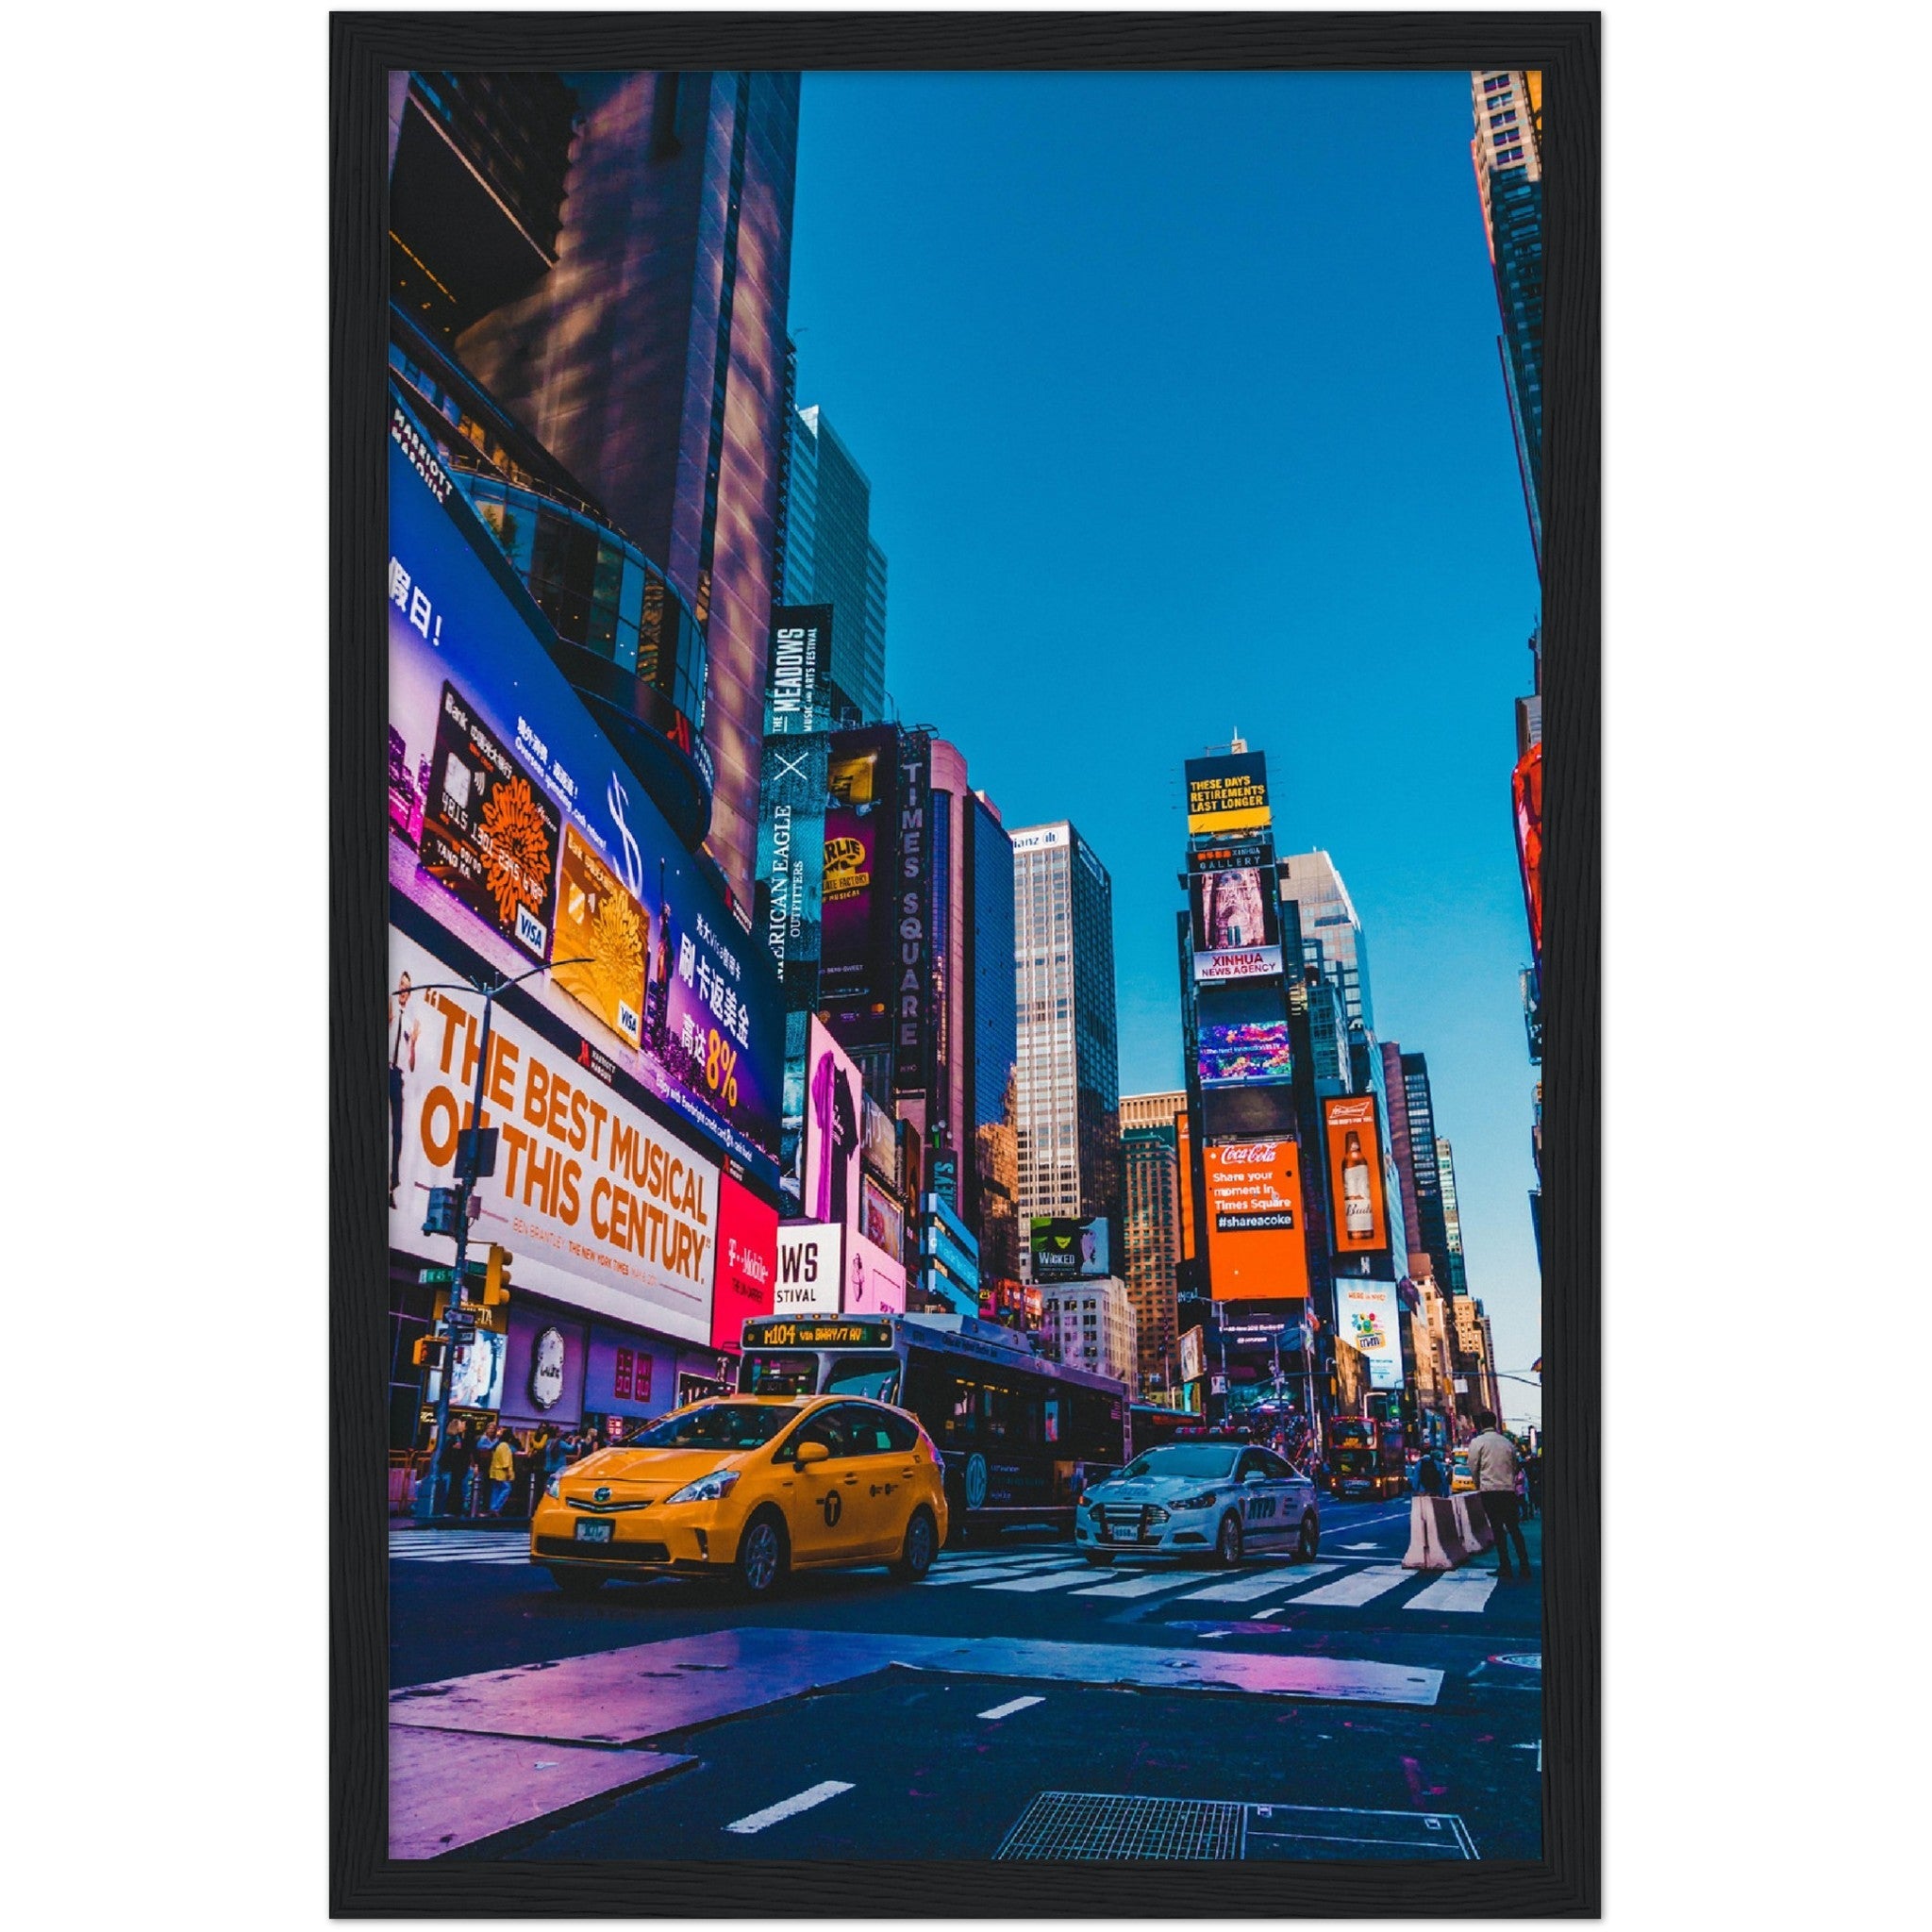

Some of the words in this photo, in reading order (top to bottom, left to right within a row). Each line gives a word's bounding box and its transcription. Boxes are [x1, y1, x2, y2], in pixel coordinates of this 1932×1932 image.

[806, 628, 818, 666] FESTIVAL
[773, 628, 806, 712] MEADOWS
[806, 668, 816, 690] ARTS
[773, 716, 783, 734] THE
[804, 705, 814, 732] MUSIC
[1191, 778, 1222, 791] THESE
[1224, 775, 1251, 787] DAYS
[1191, 785, 1265, 803] RETIREMENTS
[1191, 801, 1218, 812] LAST
[1221, 796, 1263, 809] LONGER
[900, 762, 924, 879] TIMES
[773, 805, 791, 874] EAGLE
[1199, 857, 1261, 869] GALLERY
[839, 874, 867, 888] FACTORY
[790, 860, 804, 939] OUTFITTERS
[828, 890, 860, 902] MUSICAL
[520, 912, 543, 950] VISA
[768, 878, 788, 983] ERICAN
[899, 892, 924, 1046] SQUARE
[1202, 967, 1232, 977] NEWS
[1233, 963, 1275, 975] AGENCY
[1212, 952, 1264, 967] XINHUA
[620, 1006, 638, 1032] VISA
[707, 1027, 738, 1108] 8%
[523, 1057, 608, 1162] BEST
[609, 1115, 708, 1226] MUSICAL
[502, 1122, 582, 1226] THIS
[1212, 1173, 1244, 1182] Share
[1248, 1172, 1273, 1182] your
[1214, 1186, 1260, 1197] moment
[1215, 1199, 1248, 1210] Times
[1251, 1198, 1291, 1210] Square
[1218, 1214, 1291, 1227] #shareacoke
[569, 1241, 582, 1257] THE
[774, 1241, 819, 1285] WS
[776, 1289, 817, 1304] STIVAL
[764, 1324, 796, 1345] M104
[850, 1327, 862, 1341] AV
